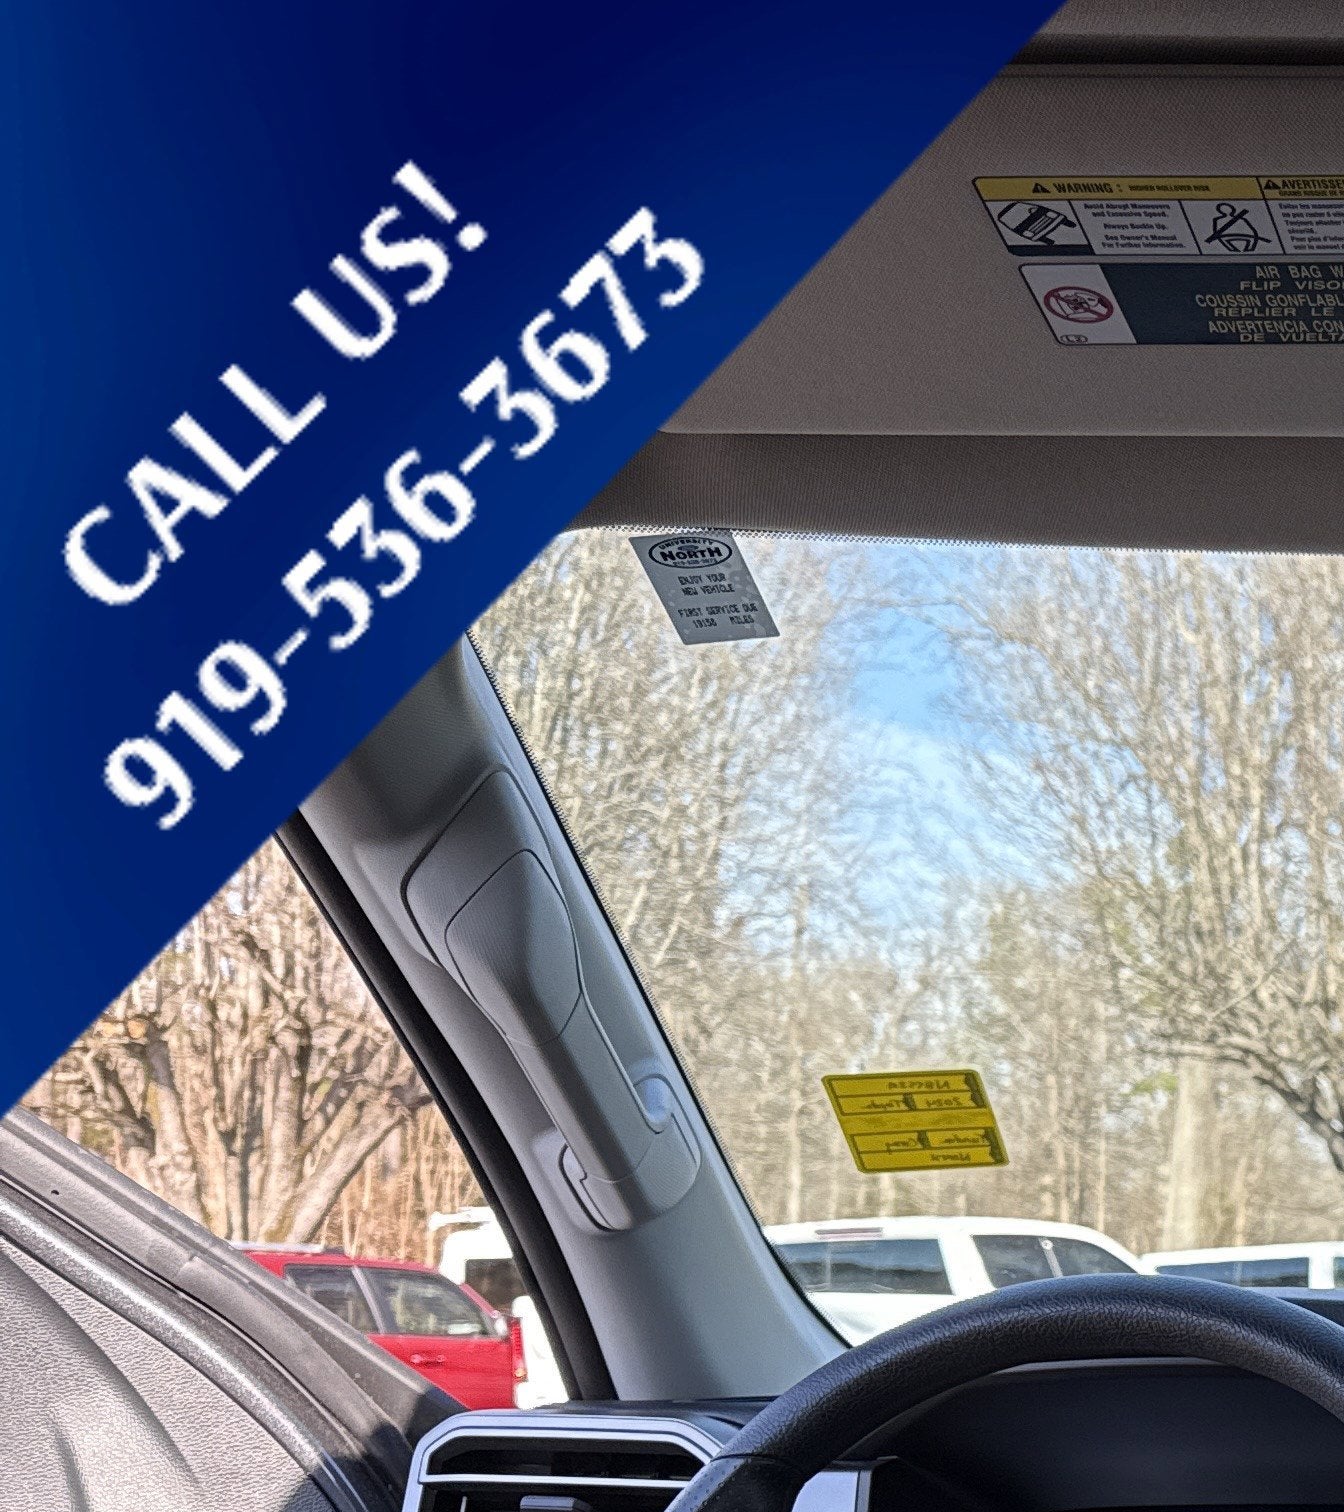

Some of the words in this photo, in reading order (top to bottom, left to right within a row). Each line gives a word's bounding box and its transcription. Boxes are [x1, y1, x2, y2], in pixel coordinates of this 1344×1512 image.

[1053, 183, 1114, 194] WARNING
[1256, 265, 1280, 279] AIR
[1288, 265, 1322, 279] BAG
[1240, 281, 1281, 290] FLIP
[1195, 294, 1261, 307] COUSSIN
[1214, 307, 1296, 317] REPLIER
[1311, 307, 1335, 316] LE
[1208, 320, 1307, 334] ADVERTENCIA
[1312, 319, 1344, 333] CON
[1240, 332, 1264, 342] DE
[660, 547, 723, 562] NORTH
